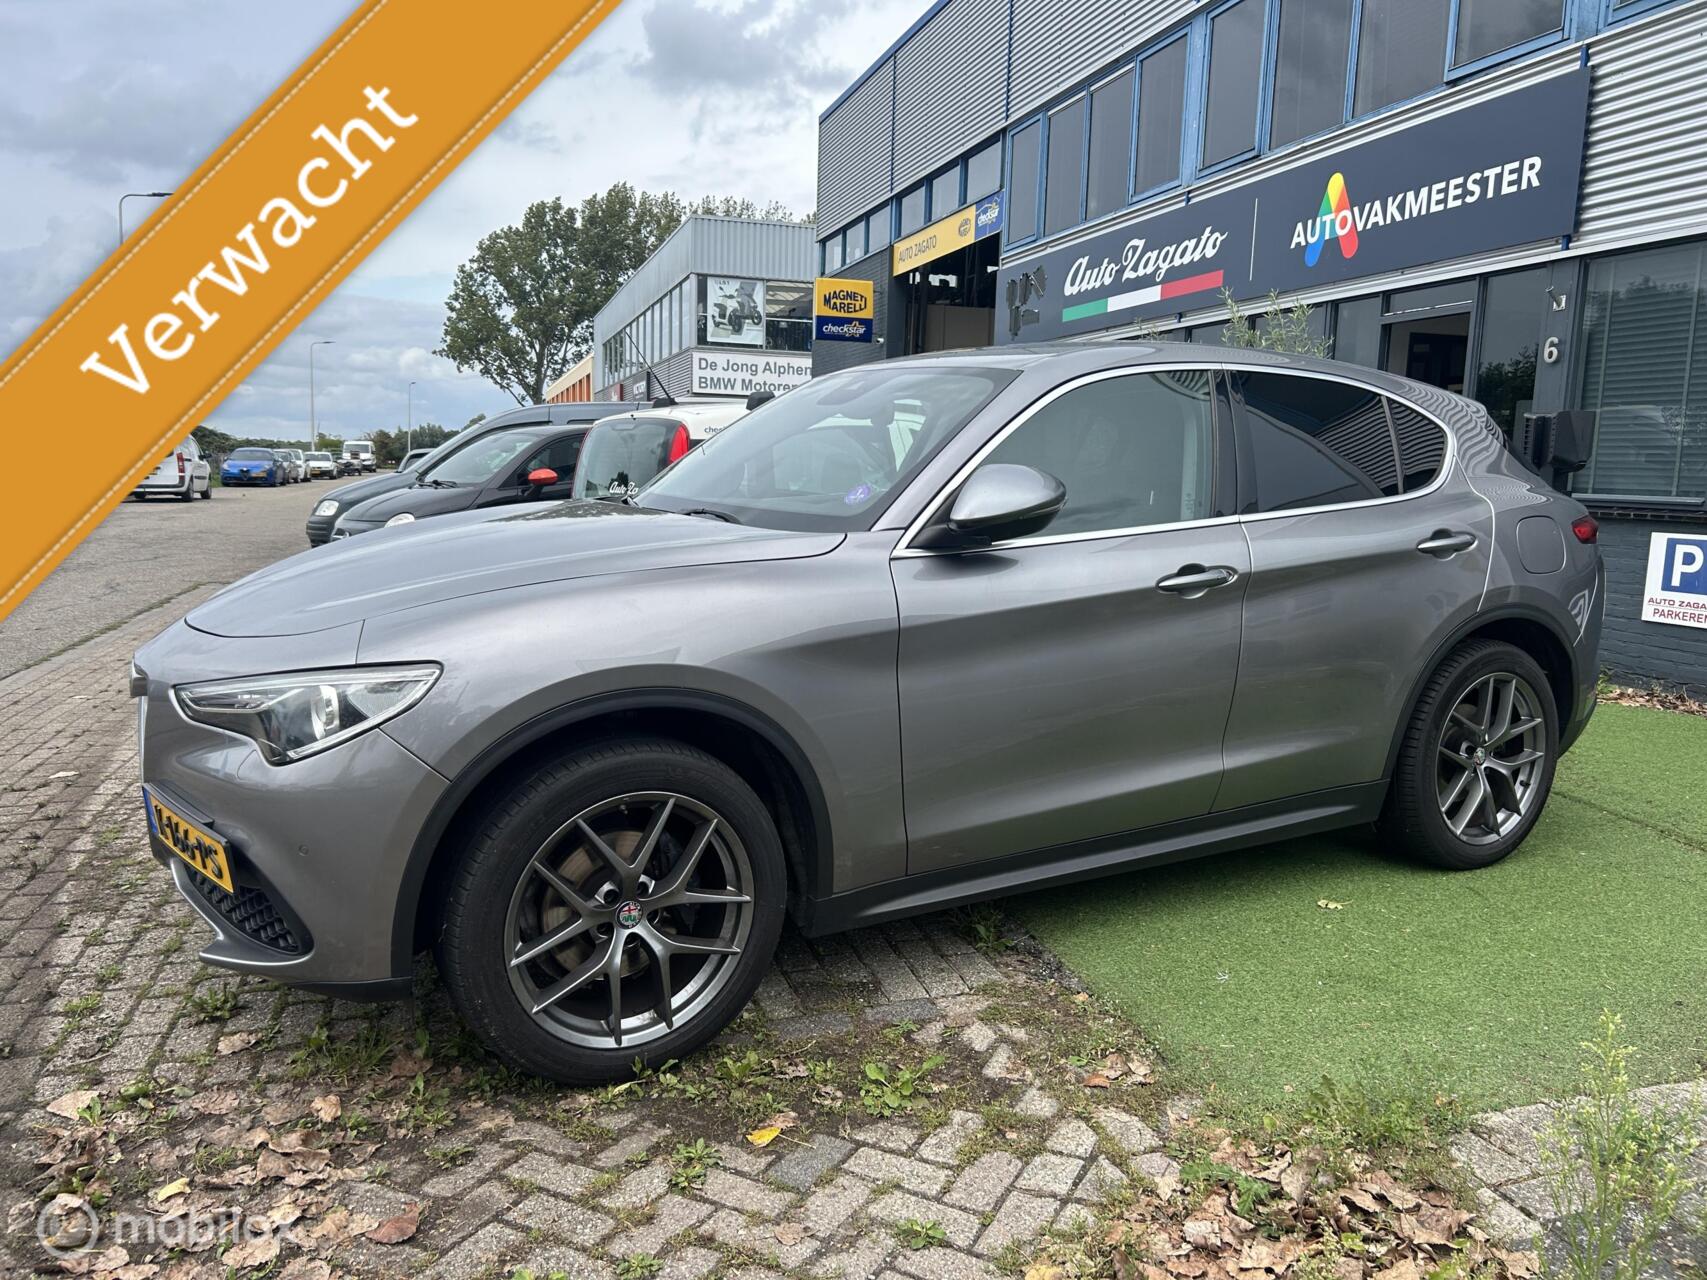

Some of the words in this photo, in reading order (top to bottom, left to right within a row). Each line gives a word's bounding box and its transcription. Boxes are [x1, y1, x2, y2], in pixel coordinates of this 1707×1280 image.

[1290, 156, 1542, 249] AUTOVAKMEESTER
[898, 246, 914, 262] AUTO
[914, 235, 937, 257] ZAGATO
[1064, 255, 1121, 296] Auto
[1121, 226, 1228, 283] Zagato
[822, 322, 867, 335] checkstar
[1543, 336, 1559, 363] 6
[698, 357, 717, 371] De
[722, 359, 758, 377] Jong
[762, 361, 812, 378] Alphen
[698, 376, 736, 391] BMW
[609, 481, 627, 494] Auto
[1671, 543, 1704, 587] P
[1648, 597, 1676, 606] AUTO
